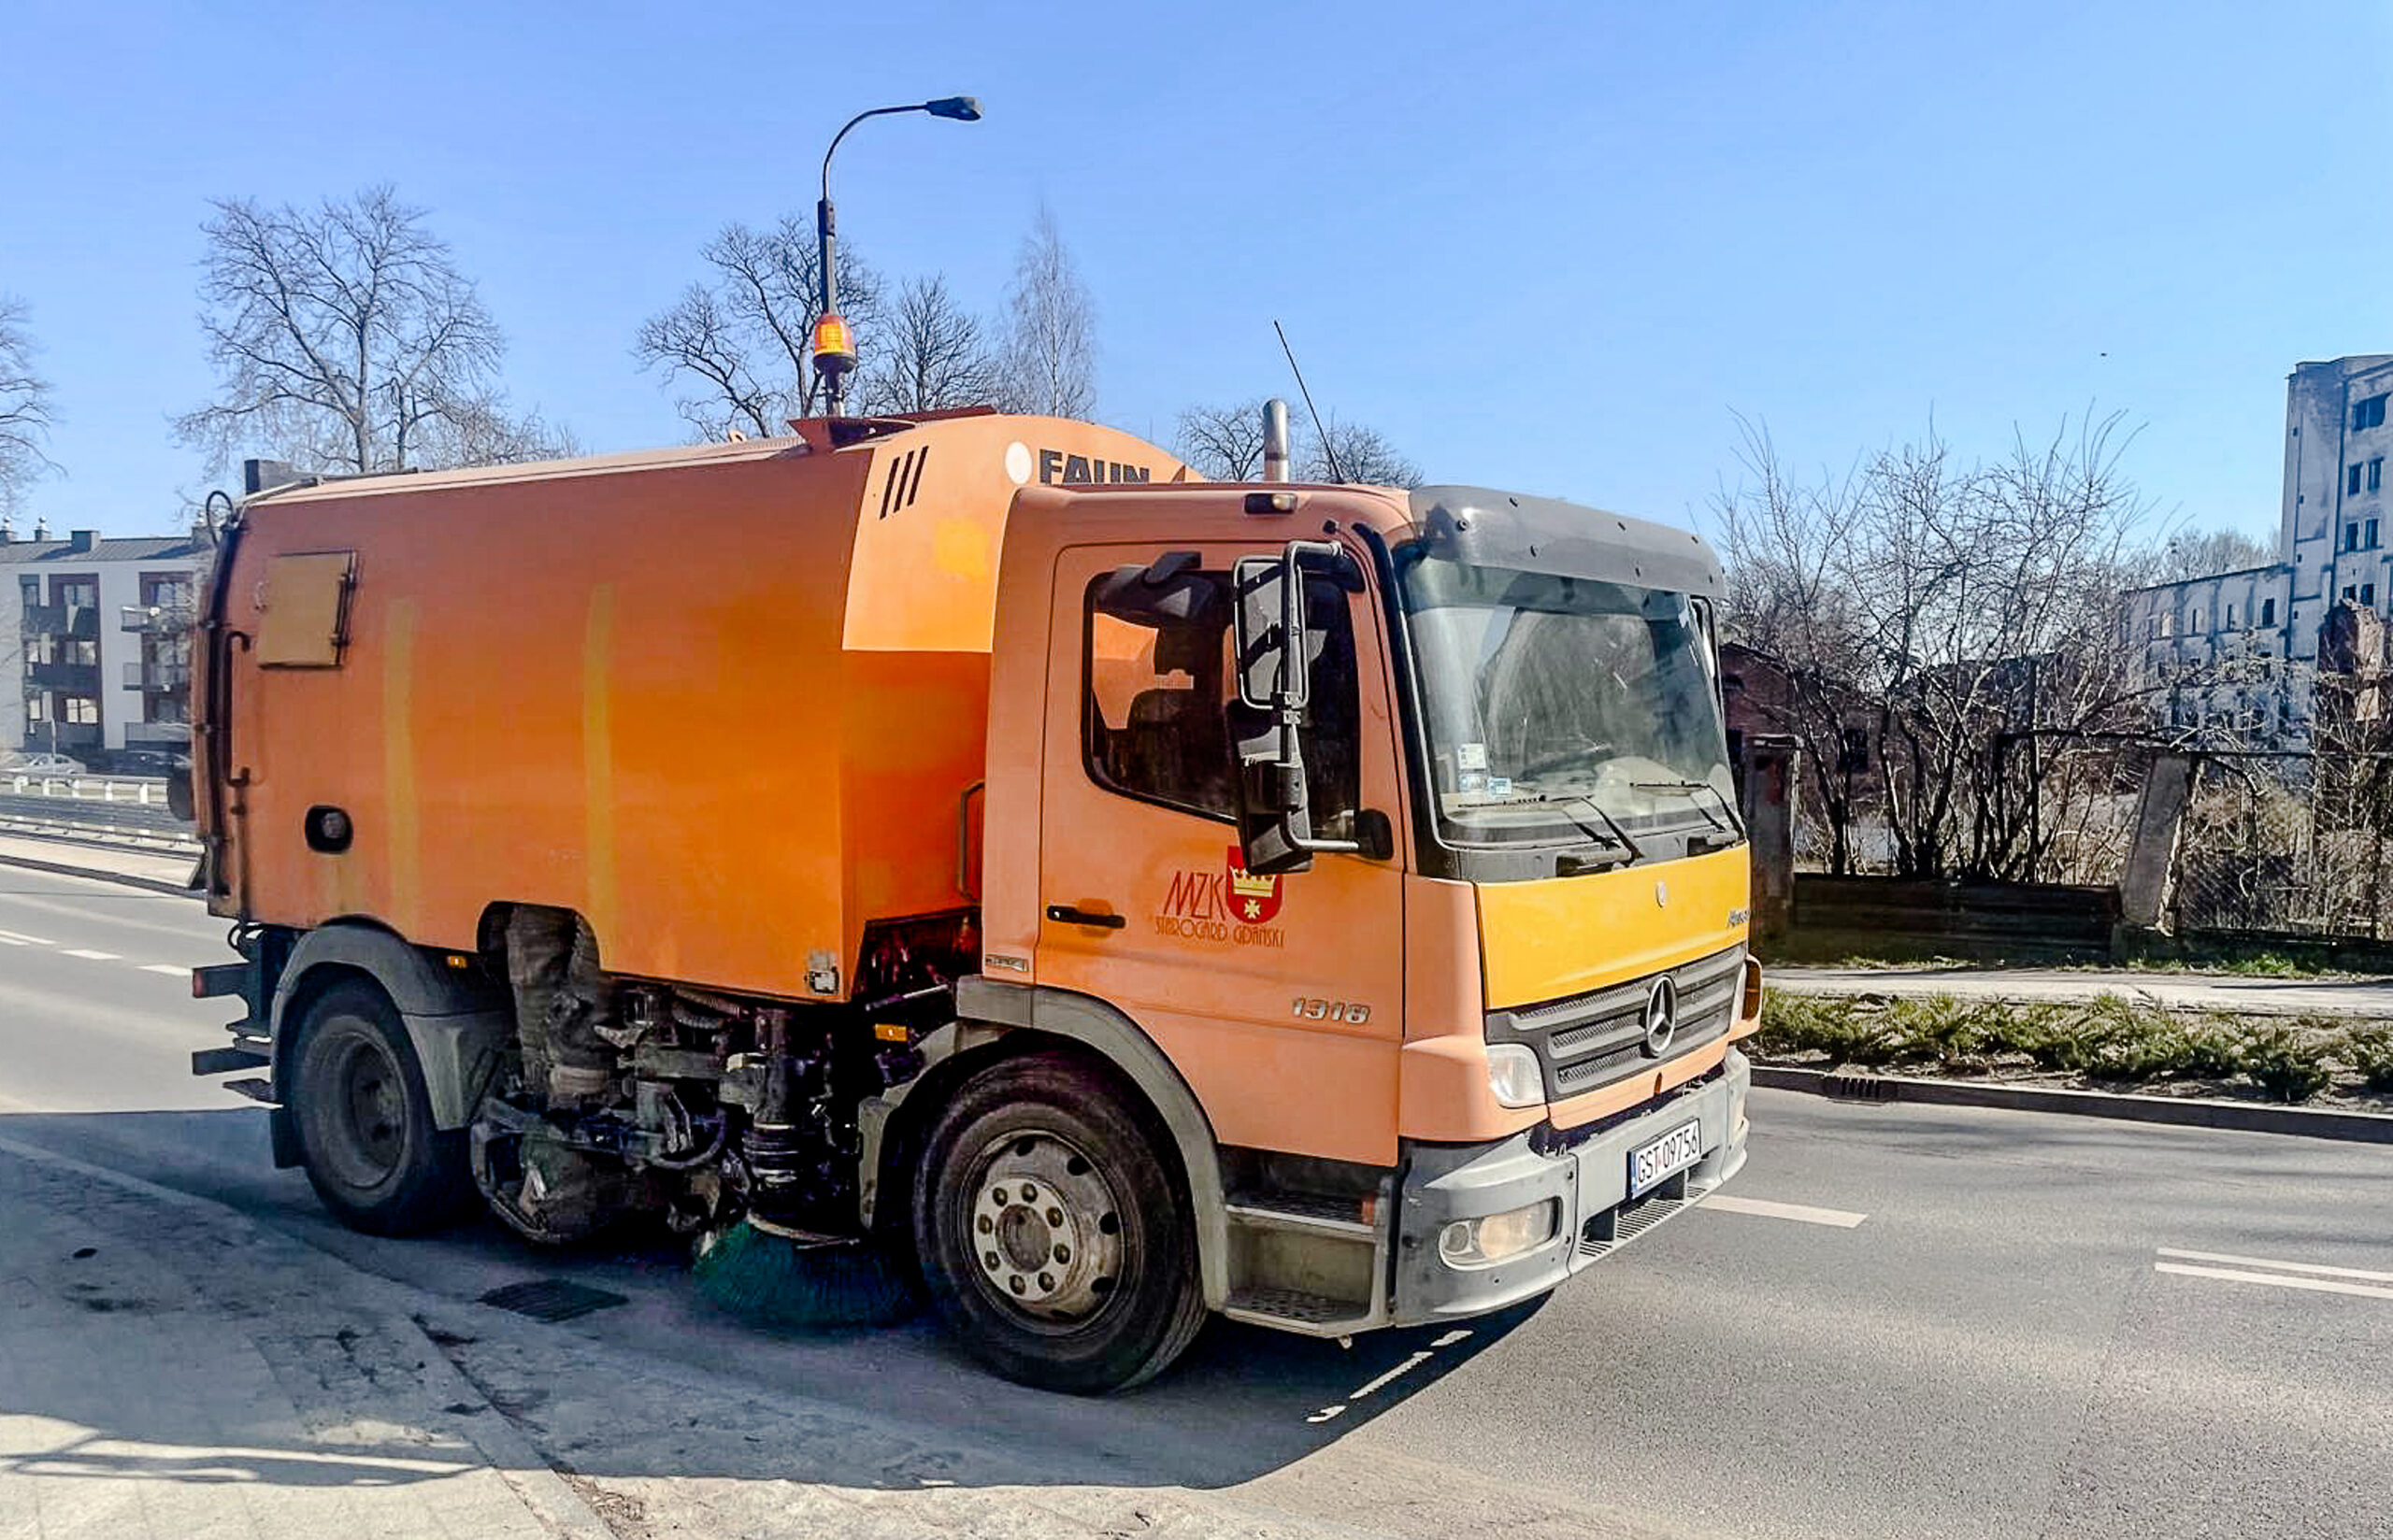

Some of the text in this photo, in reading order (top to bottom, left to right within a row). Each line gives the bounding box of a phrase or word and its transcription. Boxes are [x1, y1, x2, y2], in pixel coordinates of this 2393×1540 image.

[1163, 870, 1226, 921] MZK
[1293, 997, 1371, 1025] 1318
[1638, 1145, 1659, 1183] GST
